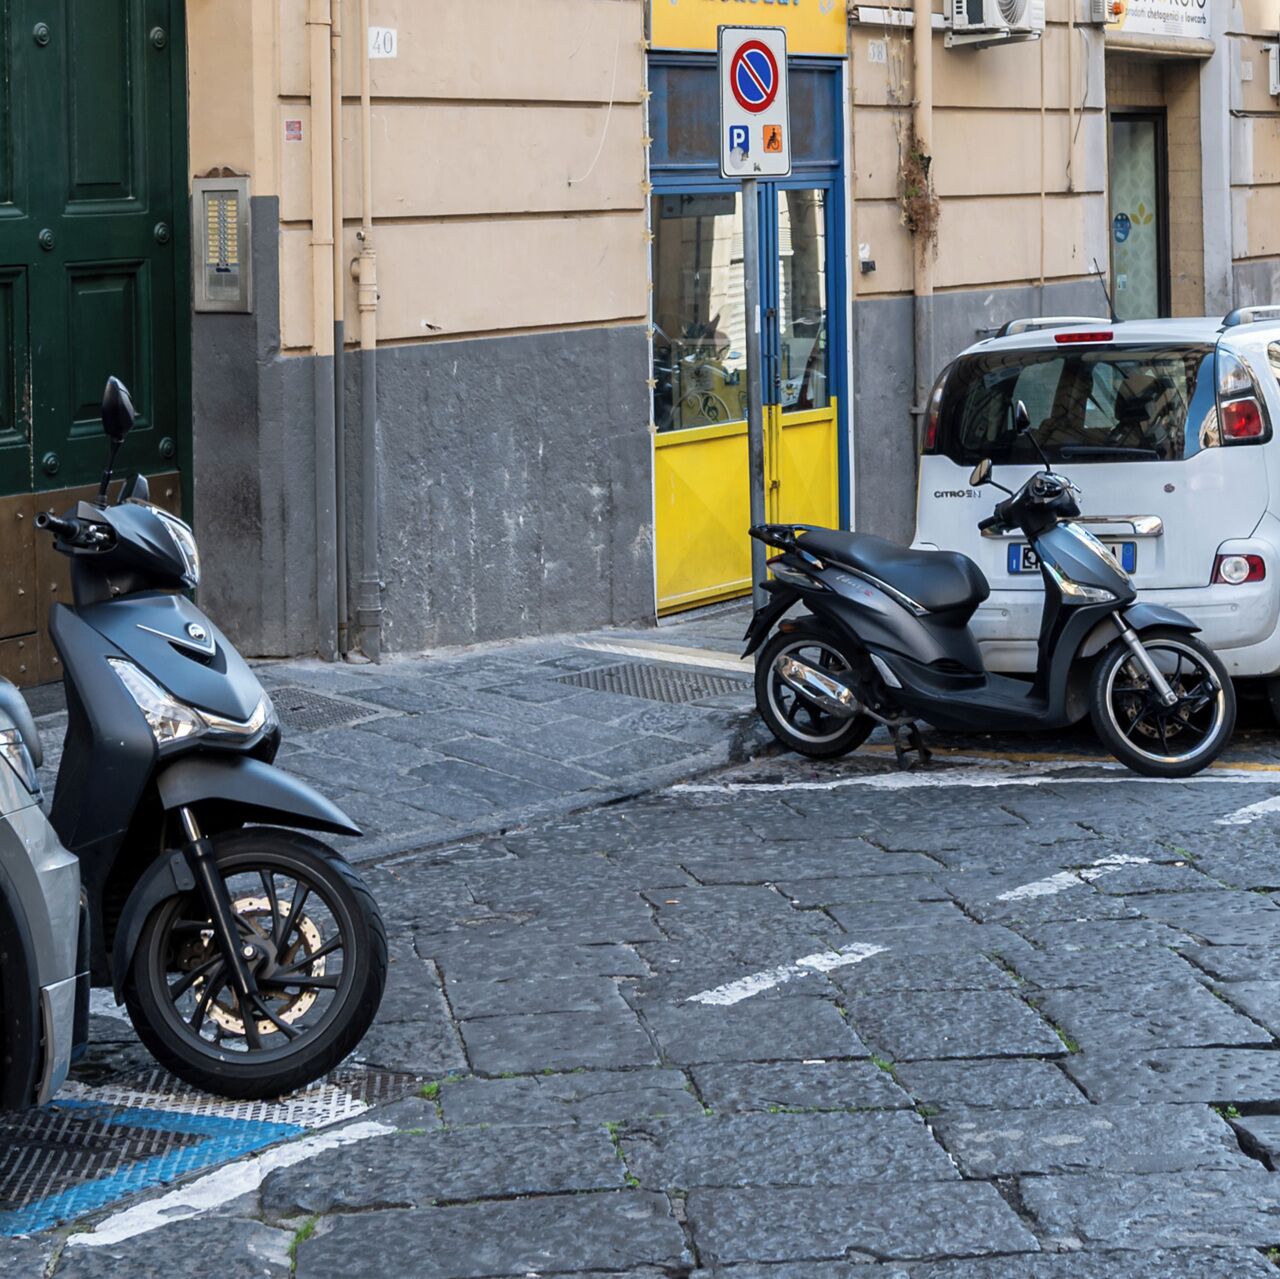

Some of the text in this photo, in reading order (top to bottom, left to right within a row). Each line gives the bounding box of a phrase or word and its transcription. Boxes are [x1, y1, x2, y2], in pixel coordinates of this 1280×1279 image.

[371, 30, 394, 54] 40
[869, 41, 884, 61] 38
[733, 128, 745, 148] P
